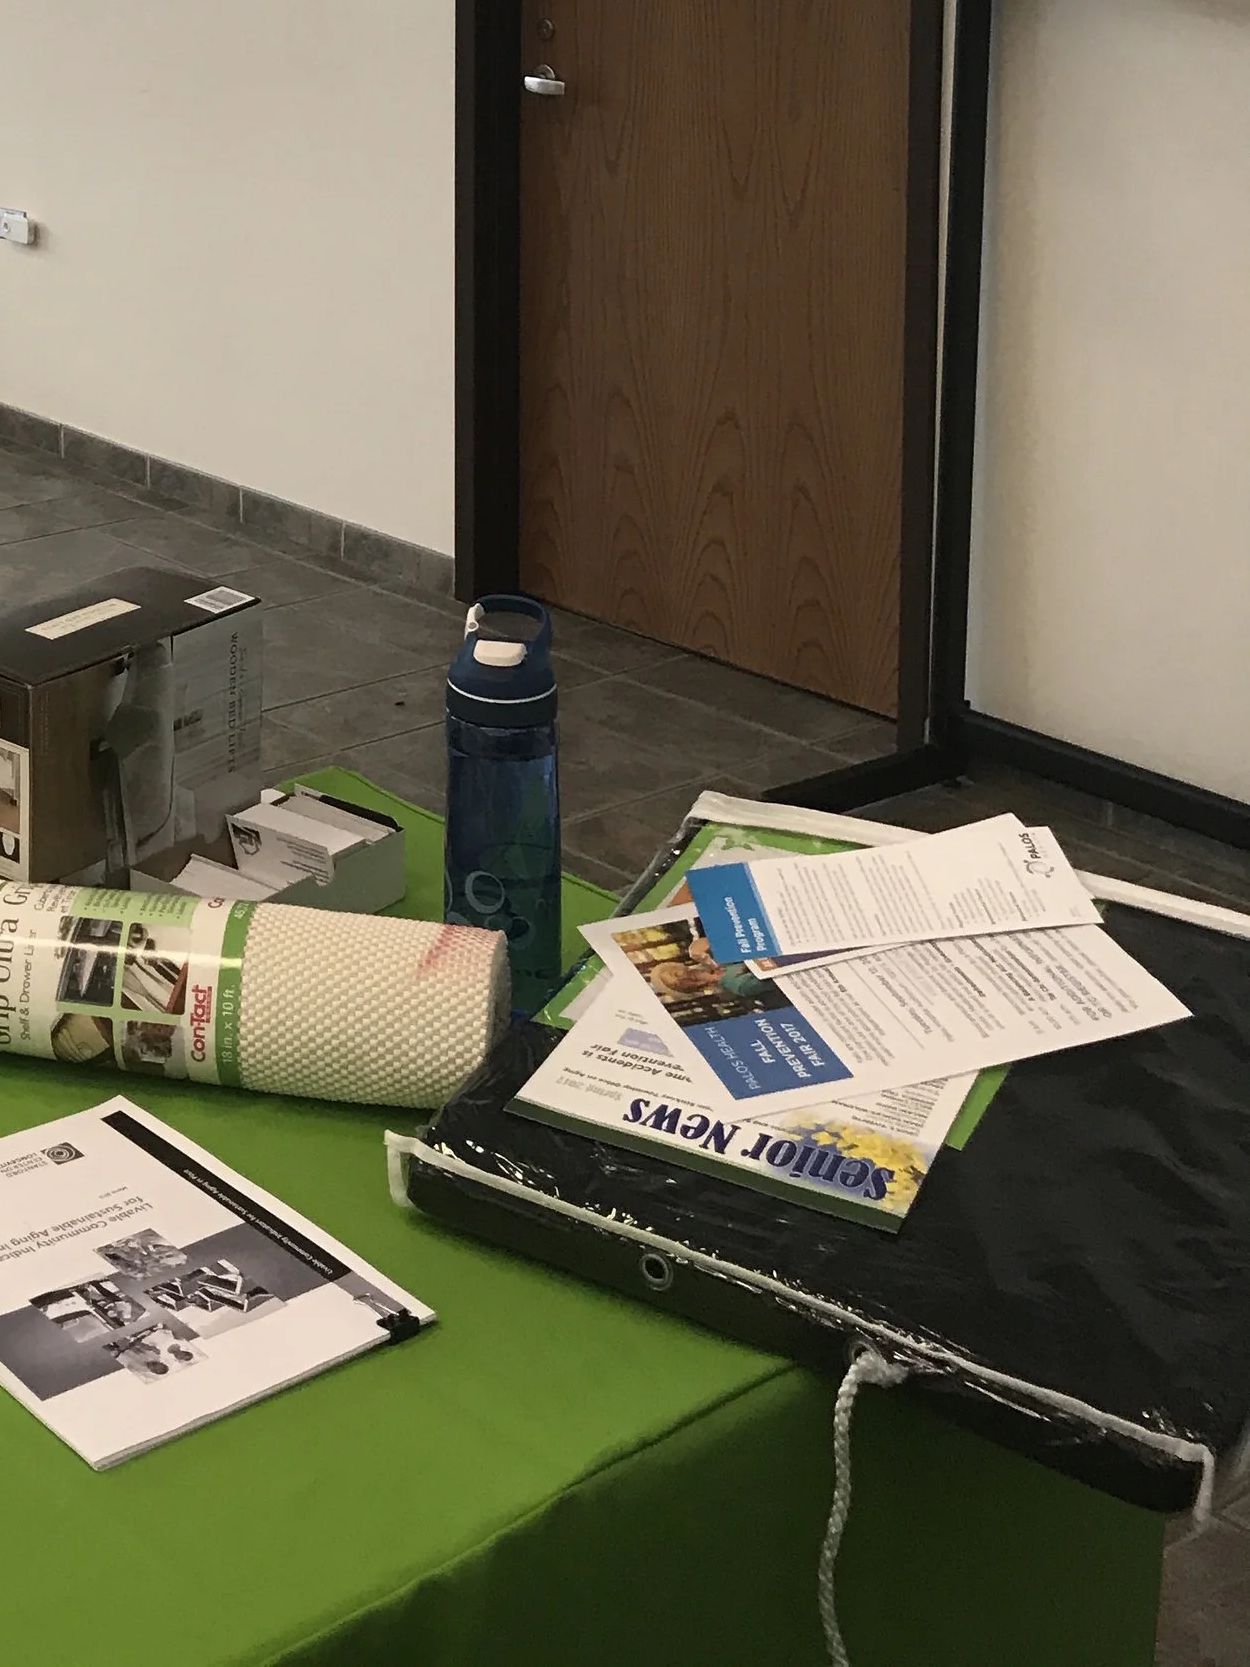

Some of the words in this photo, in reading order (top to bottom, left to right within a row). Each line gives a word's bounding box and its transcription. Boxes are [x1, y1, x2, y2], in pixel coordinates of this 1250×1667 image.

[229, 631, 238, 696] WOODEN
[1018, 832, 1041, 859] PALOS
[724, 896, 745, 938] Prevention
[737, 937, 752, 954] Fall
[748, 917, 768, 952] Program
[19, 959, 34, 1004] Drawer
[20, 1008, 30, 1016] &
[222, 1002, 234, 1016] 10
[19, 1017, 32, 1041] Shelf
[780, 1022, 808, 1046] 2017
[582, 1049, 594, 1058] is
[590, 1044, 619, 1056] Fair
[704, 1026, 736, 1059] HEALTH
[751, 1039, 775, 1064] FALL
[754, 1018, 813, 1079] PREVENTION
[596, 1055, 659, 1076] Accidents
[799, 1044, 825, 1067] FAIR
[732, 1055, 761, 1090] PALOS
[585, 1083, 623, 1101] Spring
[622, 1098, 742, 1154] News
[740, 1133, 895, 1201] Senior
[108, 1202, 154, 1225] Livable
[123, 1195, 143, 1211] for
[50, 1203, 123, 1234] Sustainable
[9, 1229, 49, 1248] Aging
[36, 1221, 108, 1250] Community
[280, 1234, 315, 1262] Community
